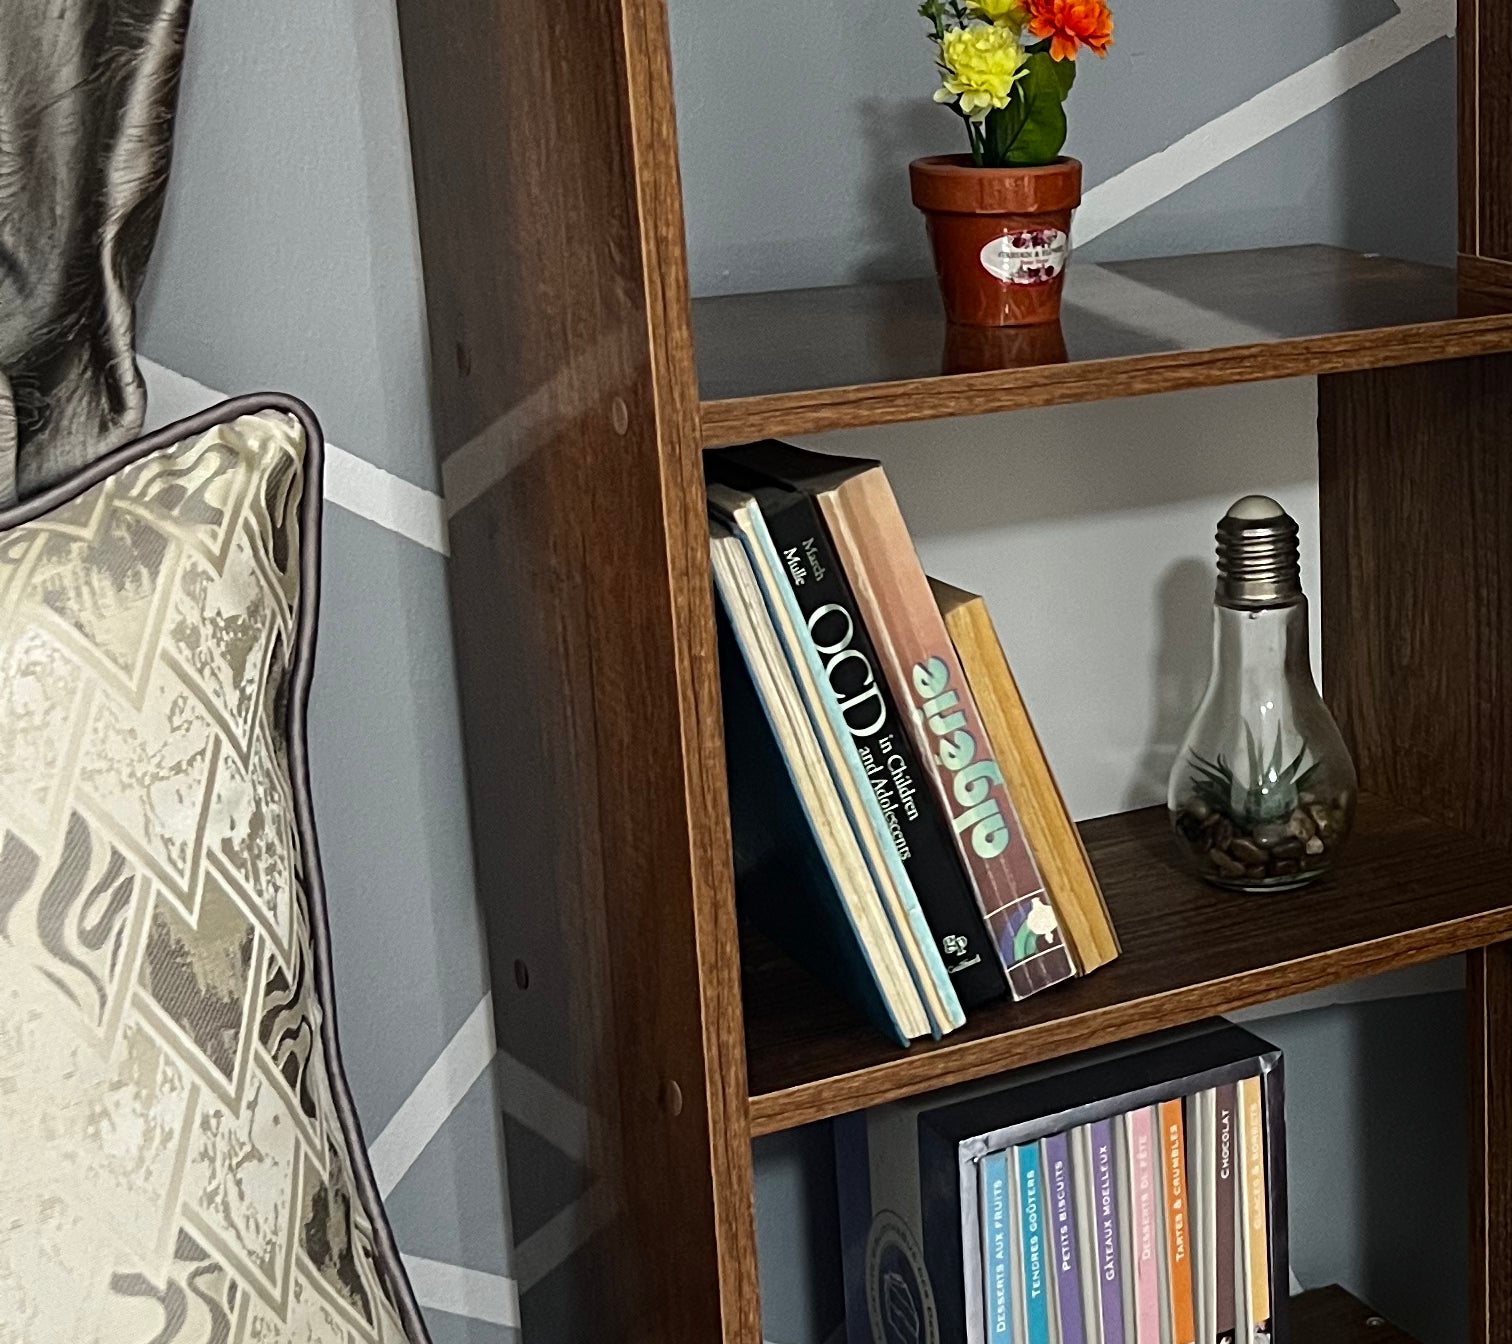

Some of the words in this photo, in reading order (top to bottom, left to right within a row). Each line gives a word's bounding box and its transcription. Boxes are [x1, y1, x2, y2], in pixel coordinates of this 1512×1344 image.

[783, 547, 806, 586] Mulle
[802, 537, 827, 582] March
[807, 603, 887, 737] OCD
[858, 746, 884, 776] and
[878, 733, 895, 754] in
[887, 754, 919, 821] Children
[870, 778, 912, 861] Adolescents
[1169, 1123, 1182, 1197] CRUMBLES
[1220, 1110, 1230, 1180] CHOCOLAT
[993, 1179, 1004, 1229] FRUITS
[1025, 1169, 1038, 1232] GOÛTERS
[1054, 1159, 1068, 1222] BISCUITS
[1098, 1144, 1112, 1217] MOELLEUX
[1139, 1175, 1150, 1189] DE
[1173, 1199, 1183, 1210] &
[994, 1231, 1005, 1259] AUX
[1060, 1224, 1073, 1273] PETITS
[1103, 1219, 1116, 1282] GÂTEAUX
[1141, 1193, 1152, 1262] DESSERTS
[1175, 1213, 1186, 1263] TARTES
[1029, 1235, 1041, 1299] TENDRES
[995, 1264, 1007, 1334] DESSERTS
